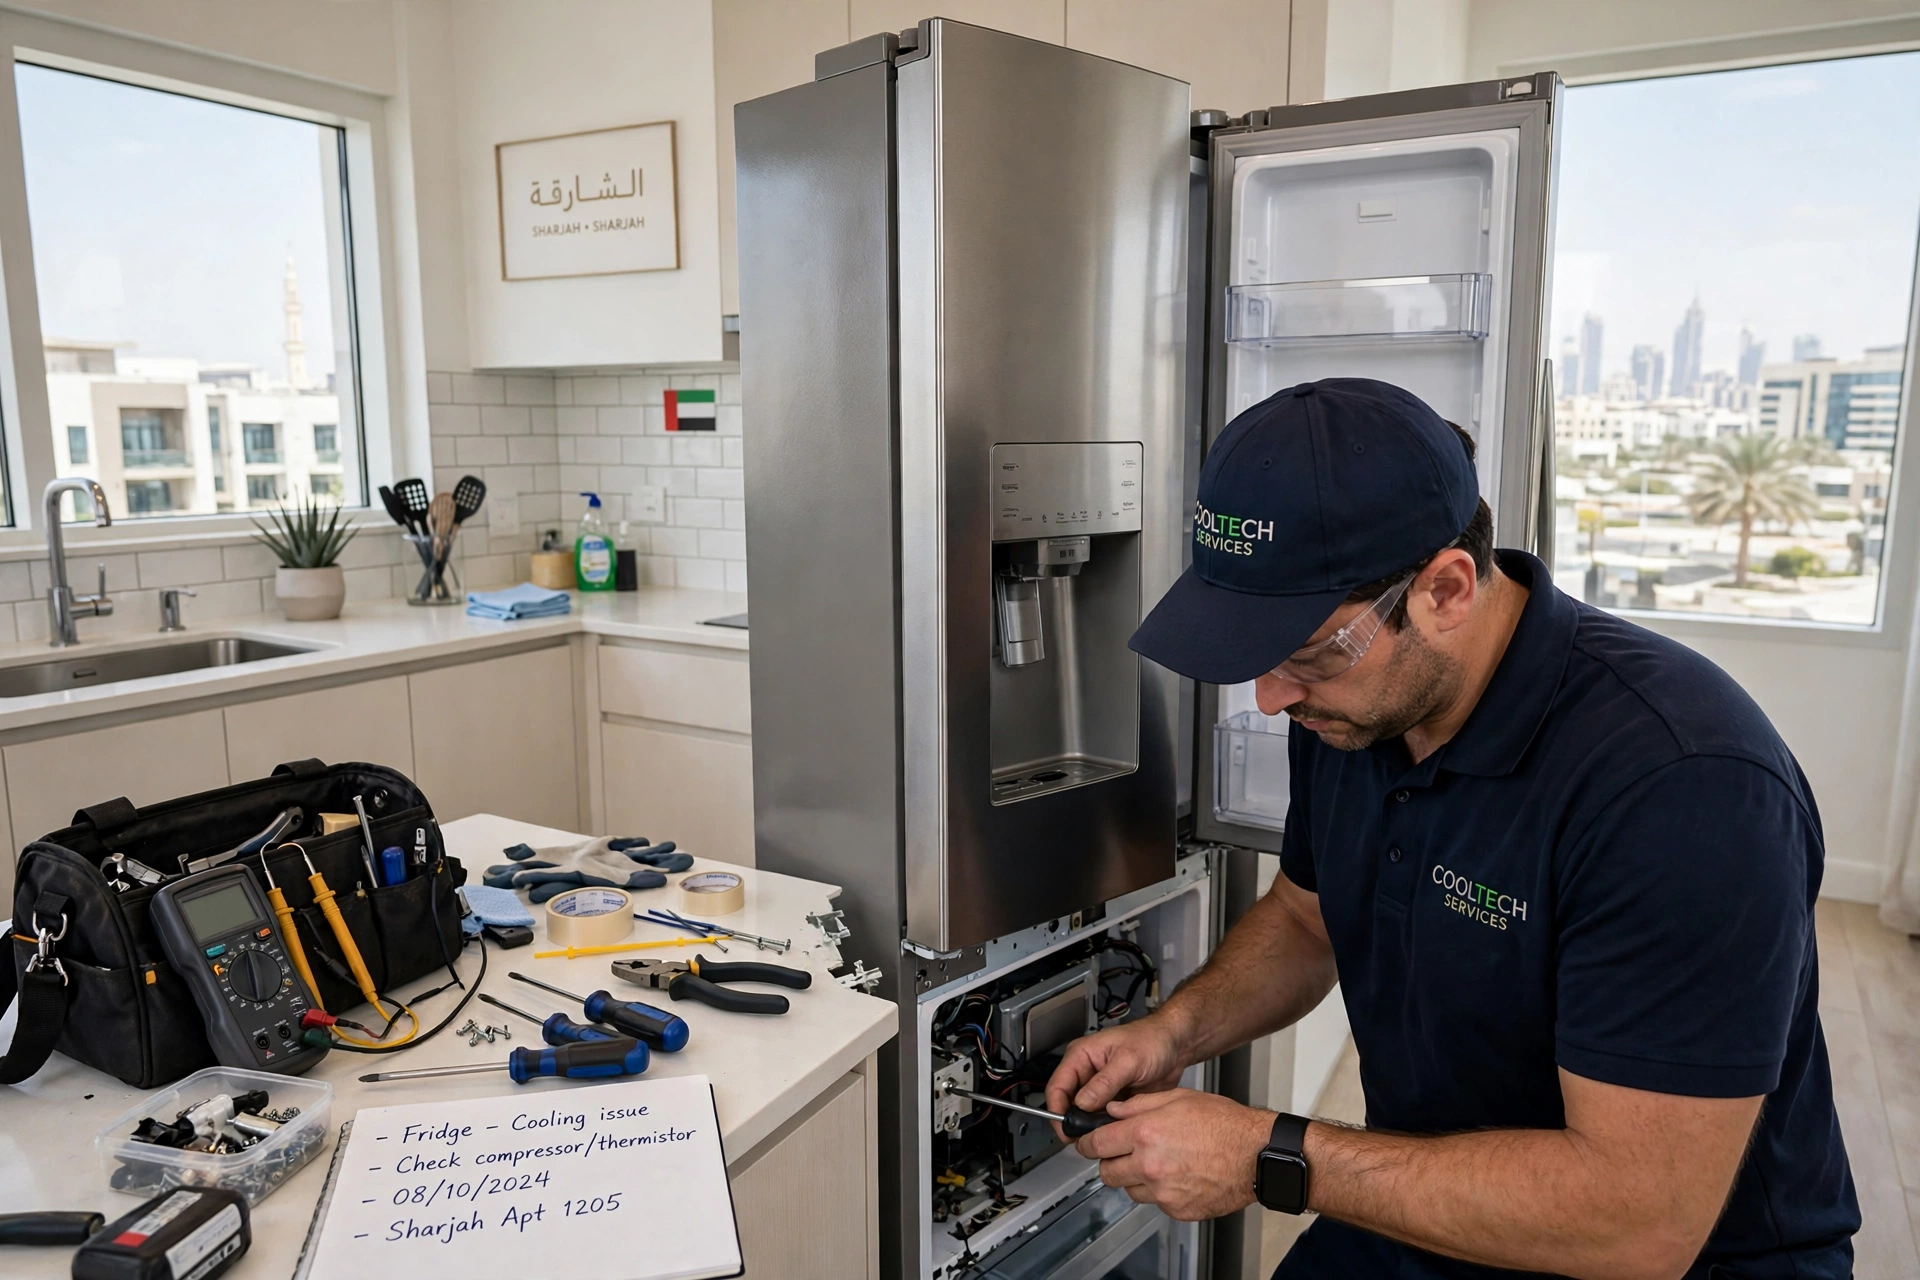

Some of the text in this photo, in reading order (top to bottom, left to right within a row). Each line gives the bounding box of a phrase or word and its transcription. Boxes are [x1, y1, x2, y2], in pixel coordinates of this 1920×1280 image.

[530, 168, 643, 212] الشارقة
[532, 216, 645, 238] SHARJAH SHARJAH
[1196, 528, 1253, 556] SERVICES
[1432, 864, 1527, 921] COOLTECH
[1443, 893, 1507, 930] SERVICES
[402, 1122, 473, 1146] Fridge
[511, 1110, 586, 1132] Cooling
[600, 1103, 650, 1121] issue
[396, 1128, 697, 1174] Check compressor/thermistor
[392, 1170, 550, 1207] 08/10/2024
[385, 1192, 623, 1244] Sharjah Apt 1205
